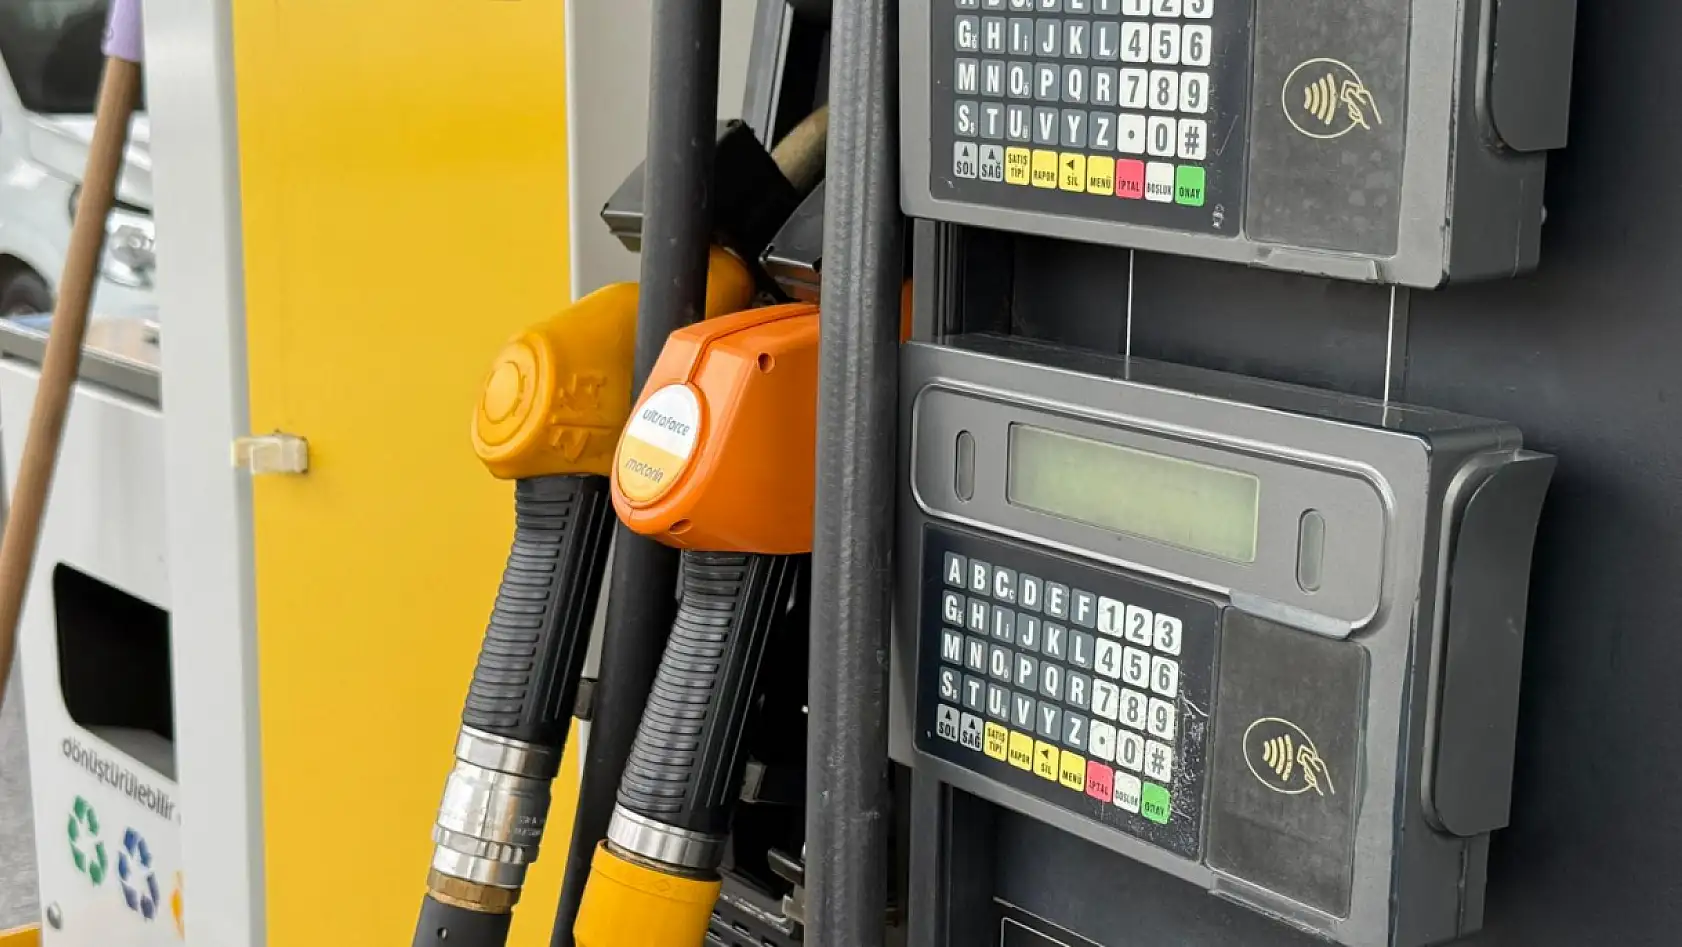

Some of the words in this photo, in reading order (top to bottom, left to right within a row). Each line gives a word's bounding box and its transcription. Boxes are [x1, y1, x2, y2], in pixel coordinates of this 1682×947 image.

[987, 21, 1000, 49] H
[1042, 24, 1054, 53] J
[1069, 25, 1083, 55] K
[1099, 26, 1111, 56] L
[1128, 29, 1141, 57] 4
[1159, 29, 1172, 59] 5
[1190, 31, 1203, 61] 6
[958, 63, 975, 91] M
[986, 65, 999, 92] N
[1040, 68, 1054, 97] P
[1068, 68, 1082, 101] Q
[1097, 72, 1110, 102] R
[1128, 76, 1140, 102] 7
[1157, 76, 1169, 106] 8
[1187, 79, 1200, 109] 9
[986, 108, 998, 135] T
[1039, 112, 1054, 140] V
[1067, 115, 1081, 143] Y
[1096, 117, 1109, 146] Z
[1155, 123, 1168, 152] 0
[1184, 126, 1200, 155] #
[956, 161, 975, 176] SOL
[981, 161, 1001, 179] SAĞ
[1033, 170, 1055, 182] RAPOR
[1090, 175, 1111, 189] MENÜ
[1179, 187, 1201, 199] ONAY
[642, 408, 690, 436] ultraforce
[625, 458, 664, 483] motorin
[948, 558, 961, 584] A
[974, 564, 985, 590] B
[1024, 579, 1037, 606] D
[1050, 587, 1063, 614] E
[1078, 594, 1091, 622] F
[1106, 605, 1116, 632] 1
[1132, 612, 1145, 640] 2
[1161, 620, 1174, 648] 3
[971, 602, 984, 630] H
[1022, 620, 1034, 646] J
[1047, 626, 1060, 655] K
[1075, 635, 1085, 664] L
[1101, 646, 1114, 672] 4
[1130, 653, 1142, 680] 5
[1159, 663, 1171, 690] 6
[944, 633, 960, 661] M
[970, 641, 983, 669] N
[1019, 656, 1033, 684] P
[1045, 666, 1059, 697] Q
[1071, 675, 1084, 705] R
[1100, 685, 1111, 712] 7
[1127, 696, 1139, 722] 8
[1155, 706, 1168, 733] 9
[939, 721, 956, 739] SOL
[962, 730, 981, 749] SAĞ
[968, 680, 980, 707] T
[1017, 697, 1030, 725] V
[1043, 707, 1056, 734] Y
[1068, 717, 1082, 745] Z
[1123, 737, 1136, 764] 0
[1151, 747, 1165, 775] #
